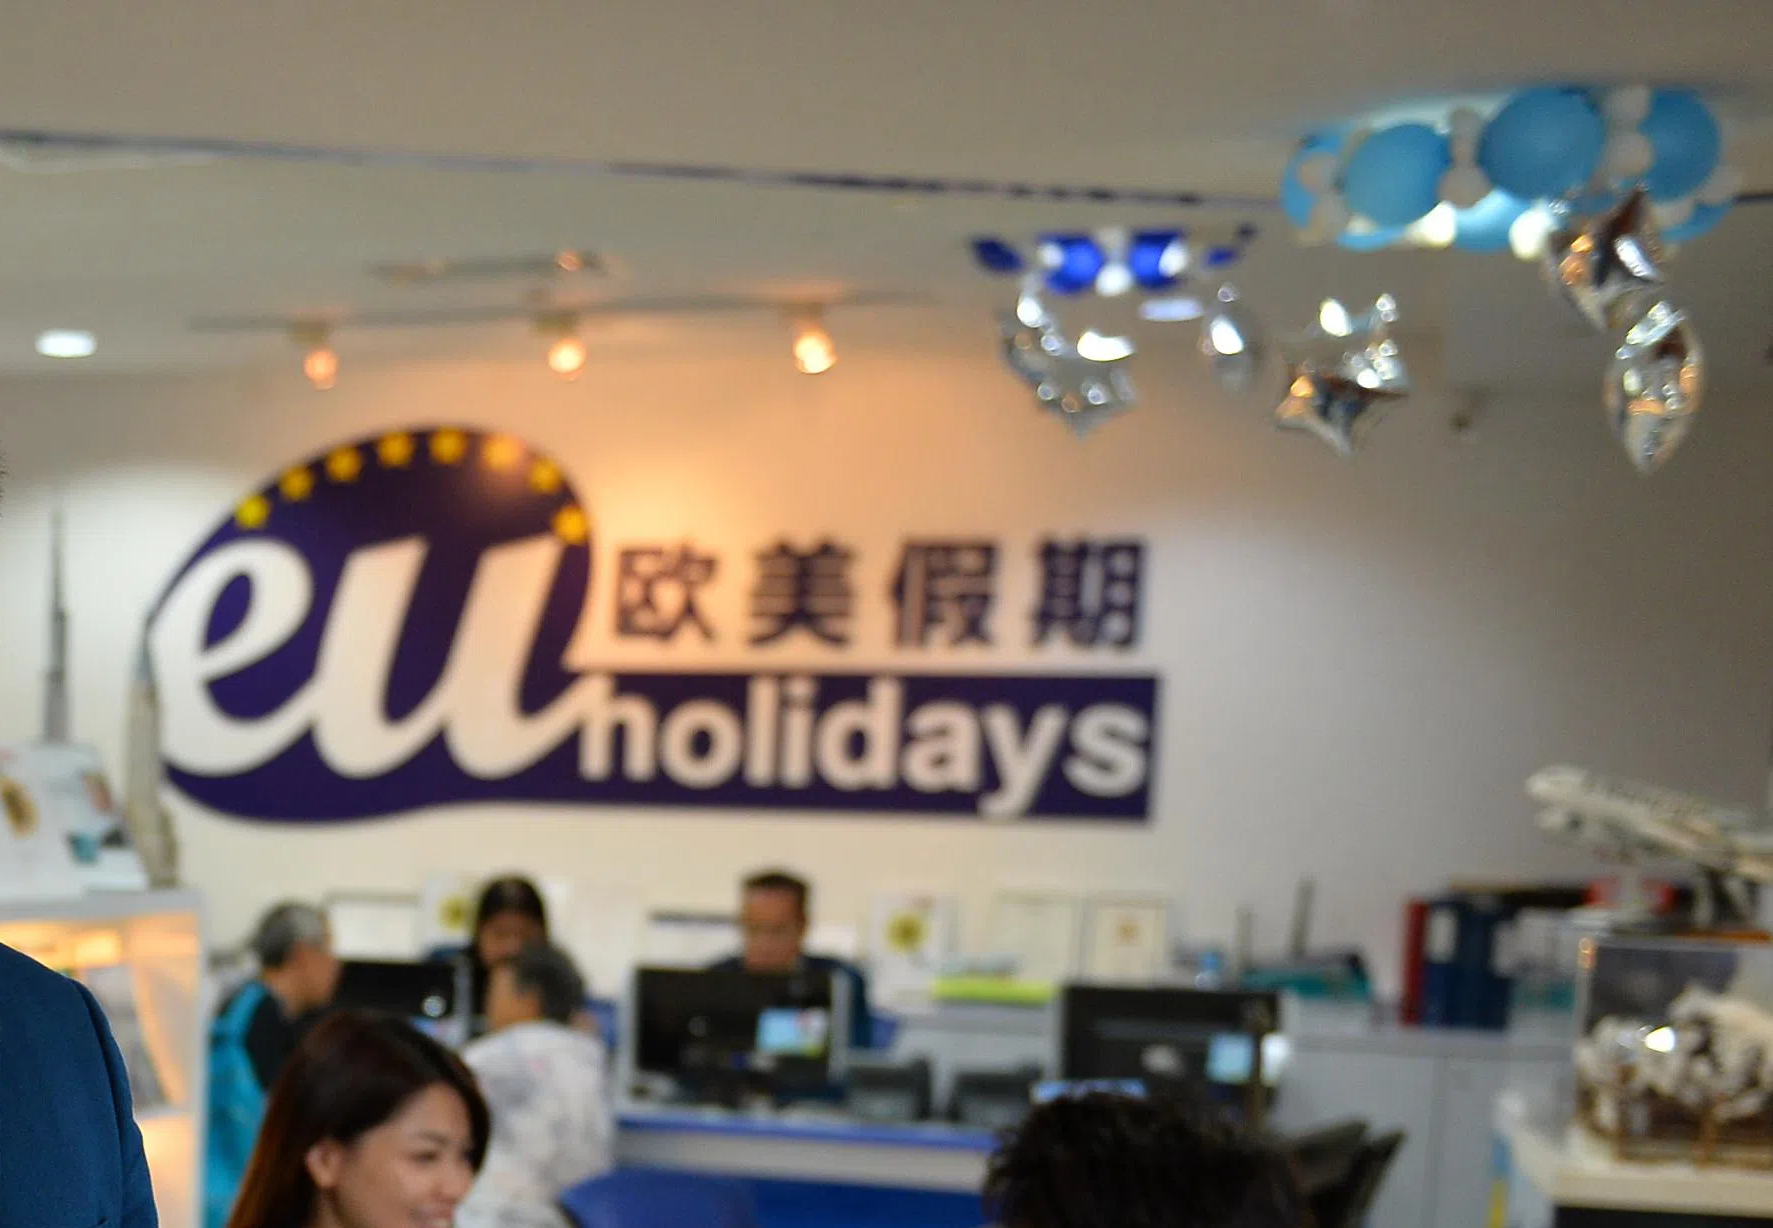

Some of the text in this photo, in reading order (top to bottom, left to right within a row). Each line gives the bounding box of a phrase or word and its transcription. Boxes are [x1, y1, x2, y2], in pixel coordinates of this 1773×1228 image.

[146, 534, 588, 781] eu
[616, 538, 1145, 650] 欧美假期
[576, 674, 1150, 822] holidays
